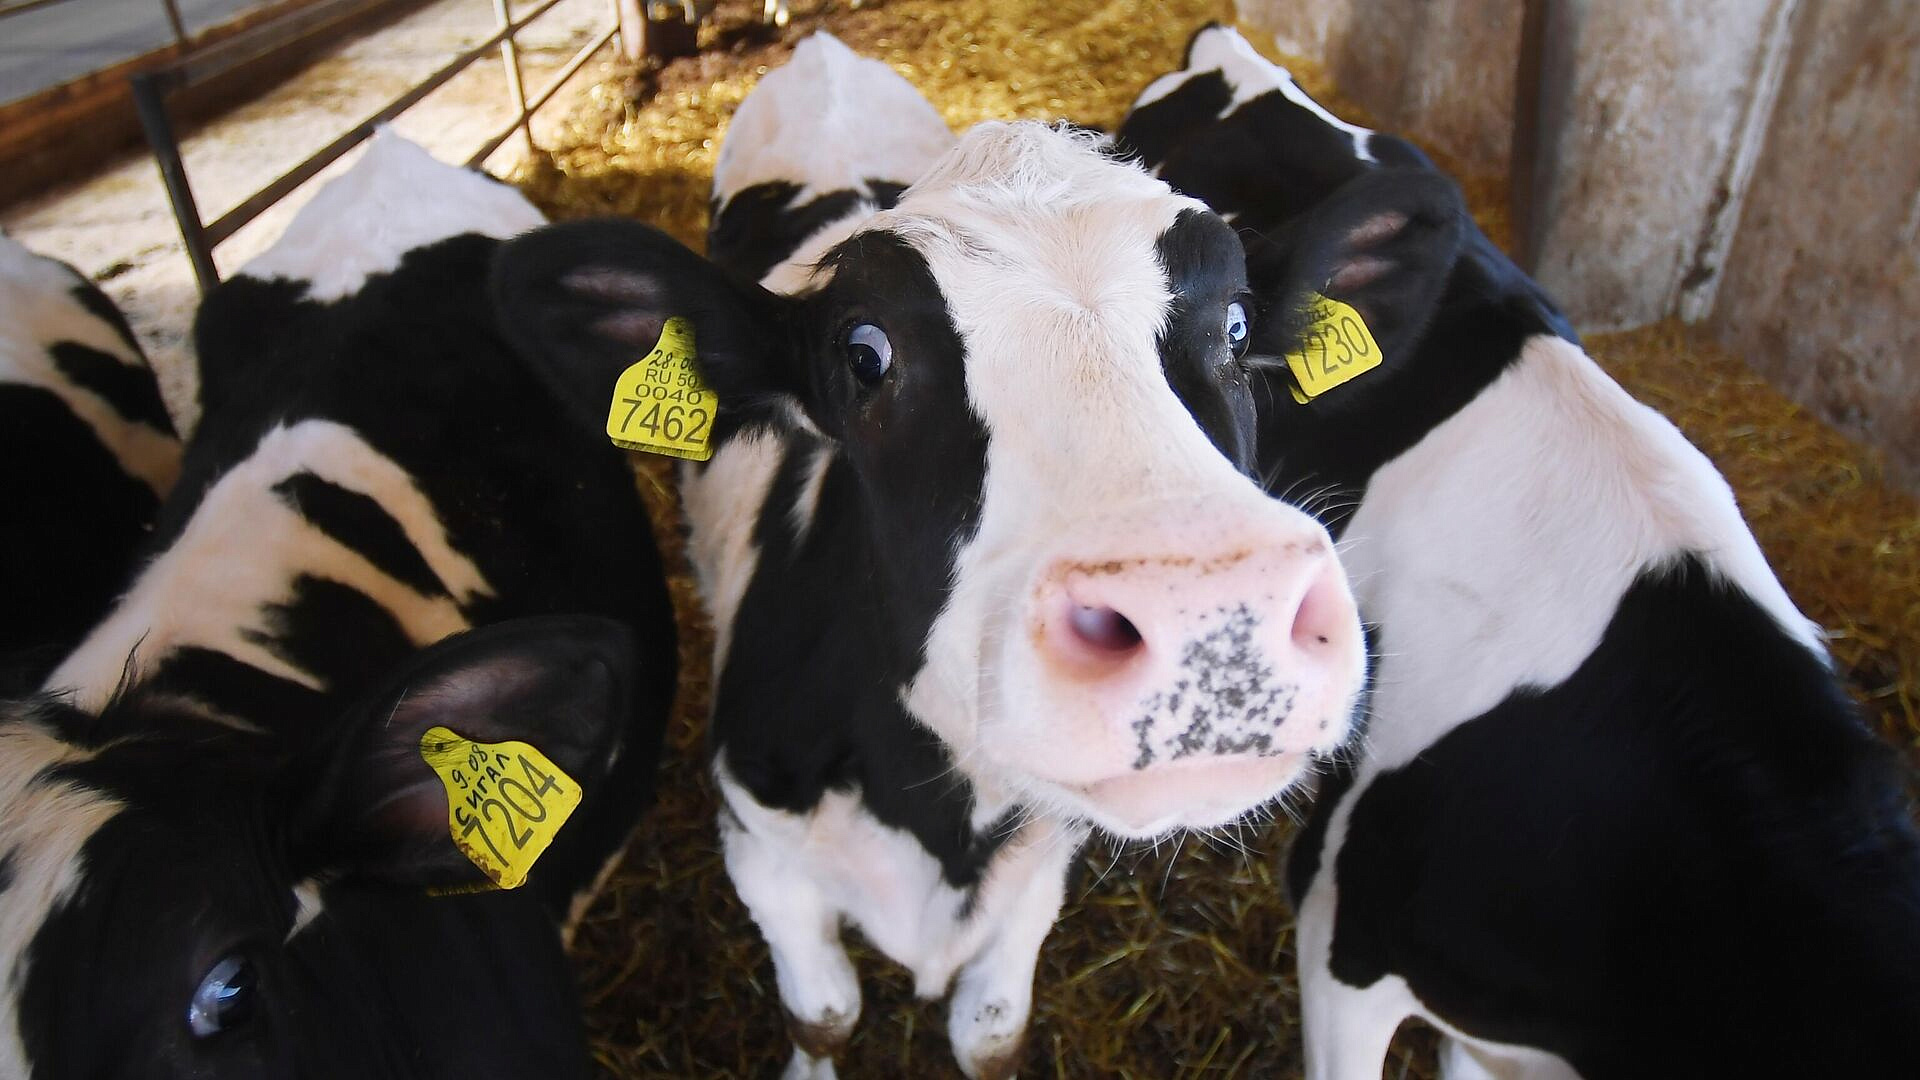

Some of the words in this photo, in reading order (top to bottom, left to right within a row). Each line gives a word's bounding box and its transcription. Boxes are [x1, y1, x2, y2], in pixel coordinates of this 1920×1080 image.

[645, 368, 672, 384] RU
[635, 384, 702, 405] 0040
[620, 398, 708, 444] 7462
[462, 754, 564, 868] 7204
